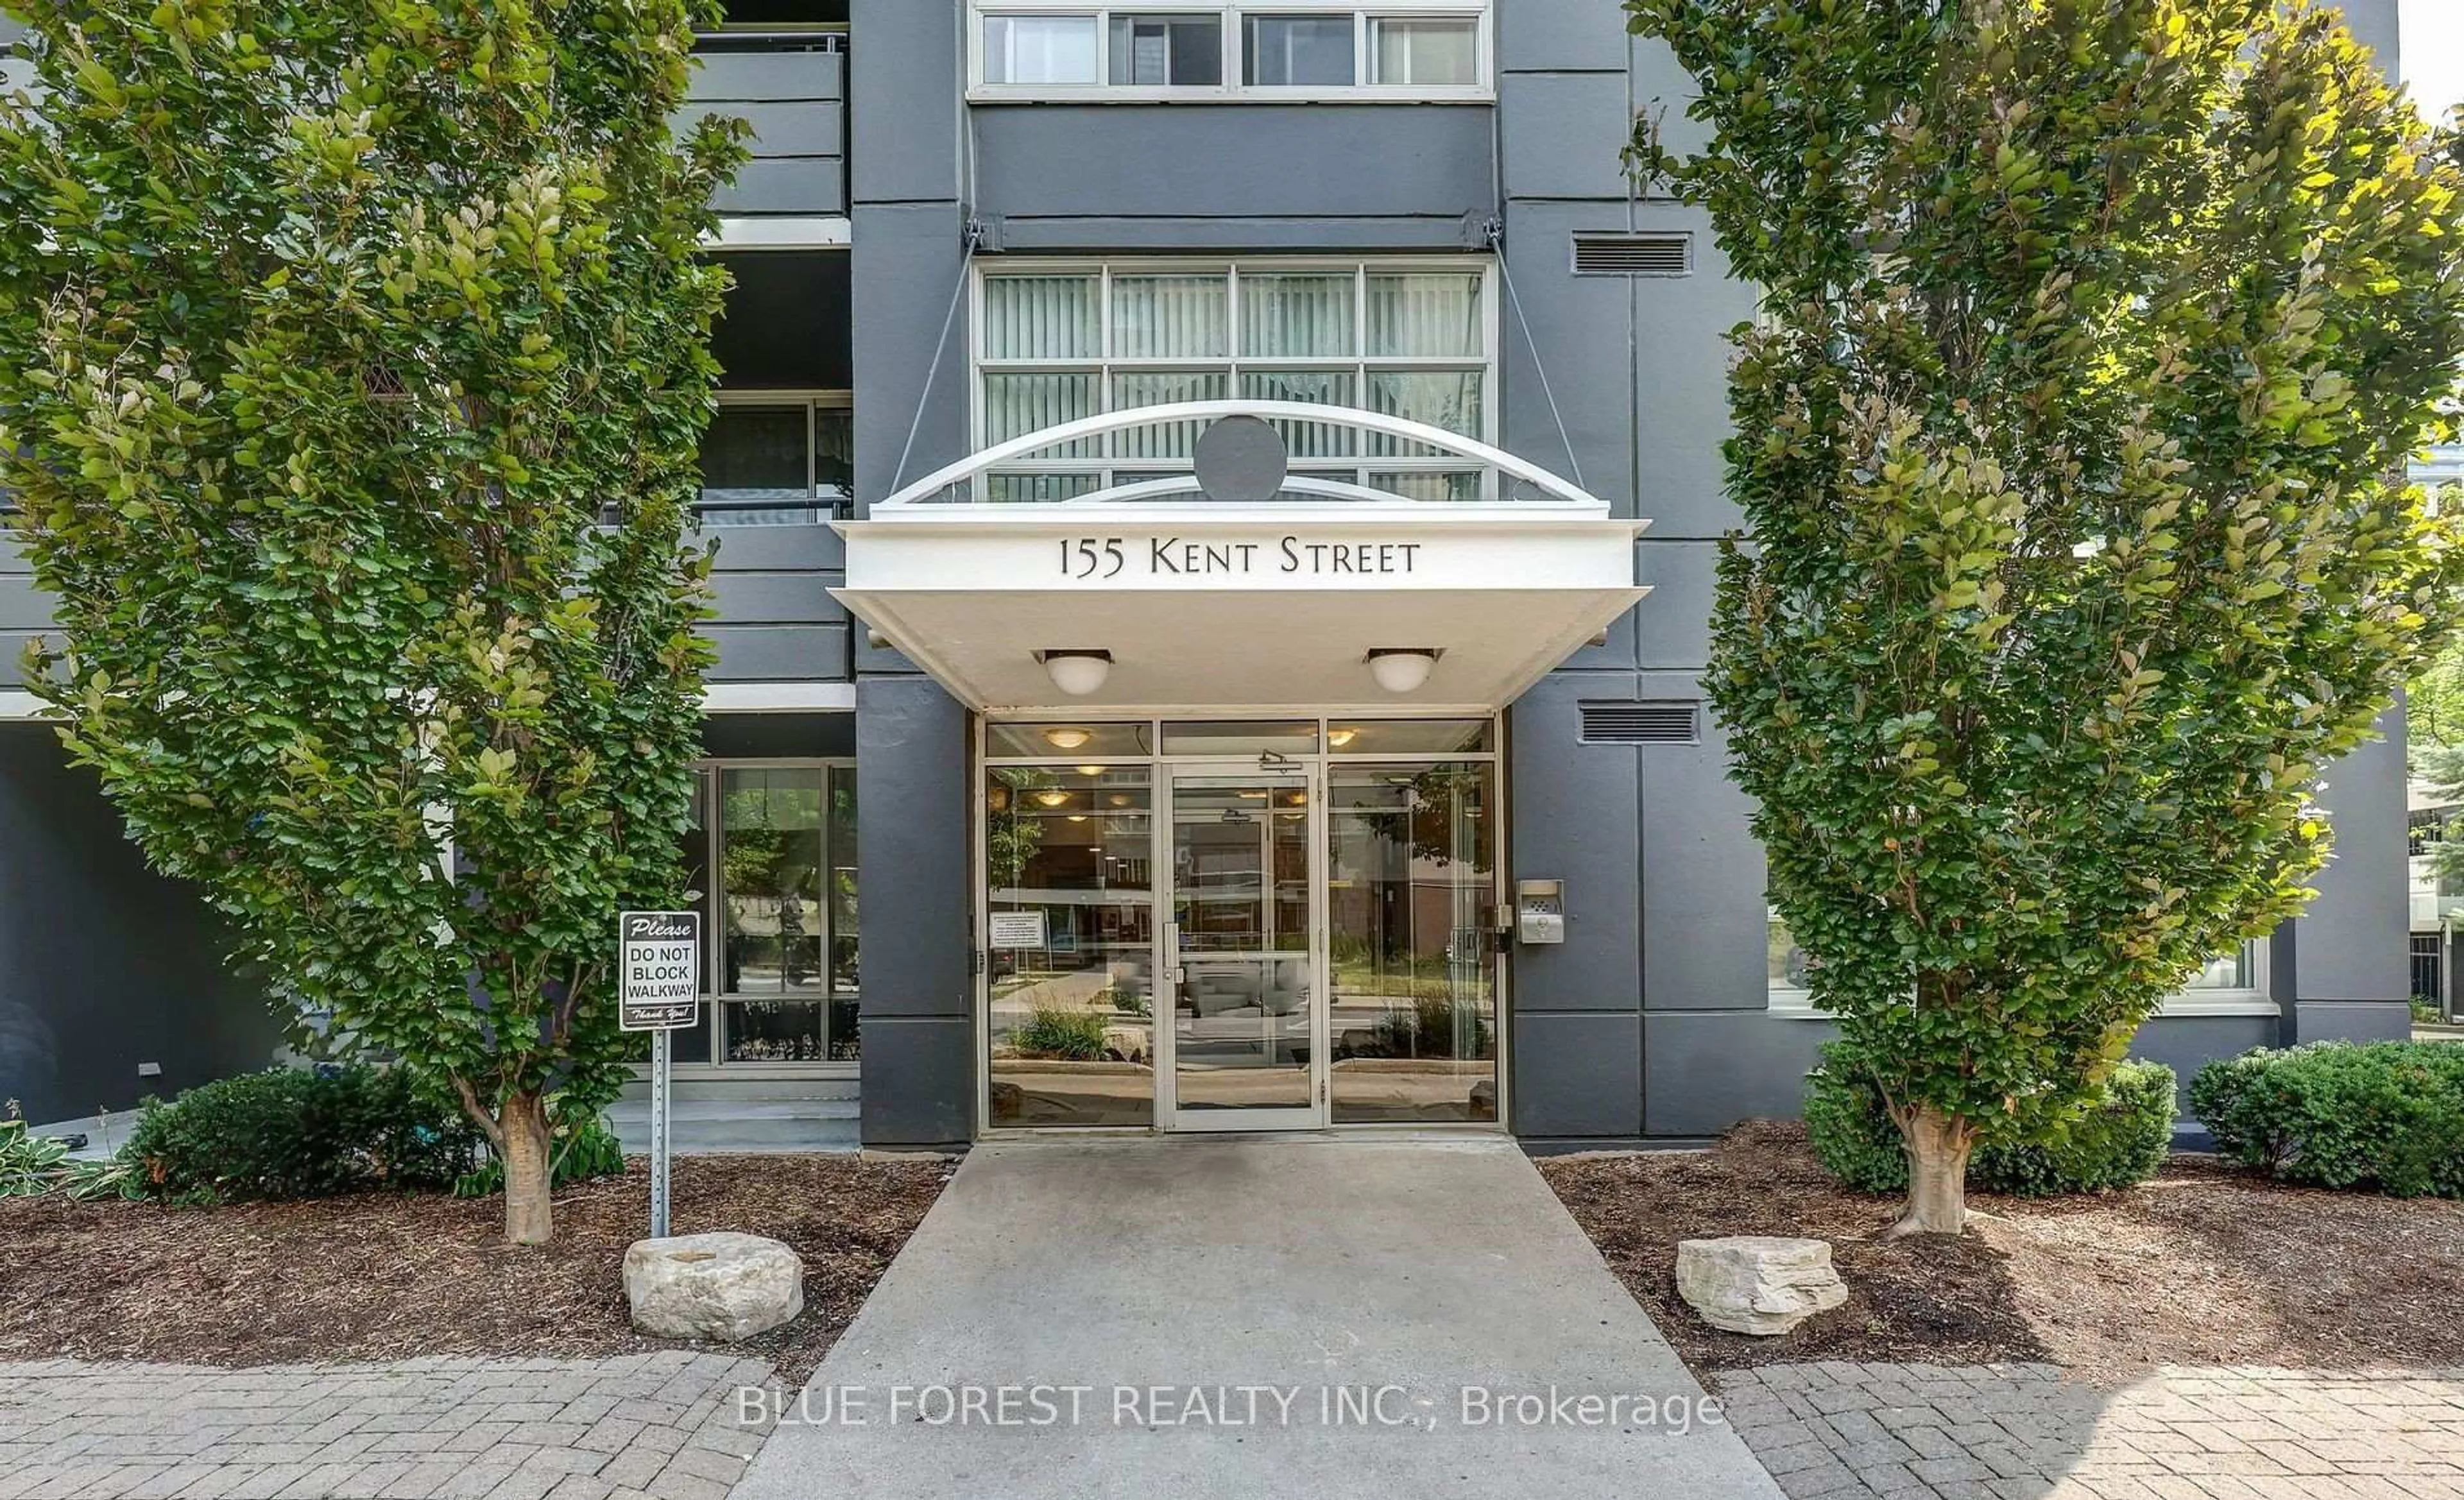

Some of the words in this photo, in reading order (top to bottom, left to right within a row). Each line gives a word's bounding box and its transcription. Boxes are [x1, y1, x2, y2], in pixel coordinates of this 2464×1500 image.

[1059, 538, 1124, 579] 155
[631, 918, 692, 937] Please
[631, 948, 654, 962] DO
[660, 948, 691, 962] NOT
[633, 966, 689, 980] BLOCK
[628, 984, 694, 998] WALKWAY
[631, 1009, 663, 1019] Thank
